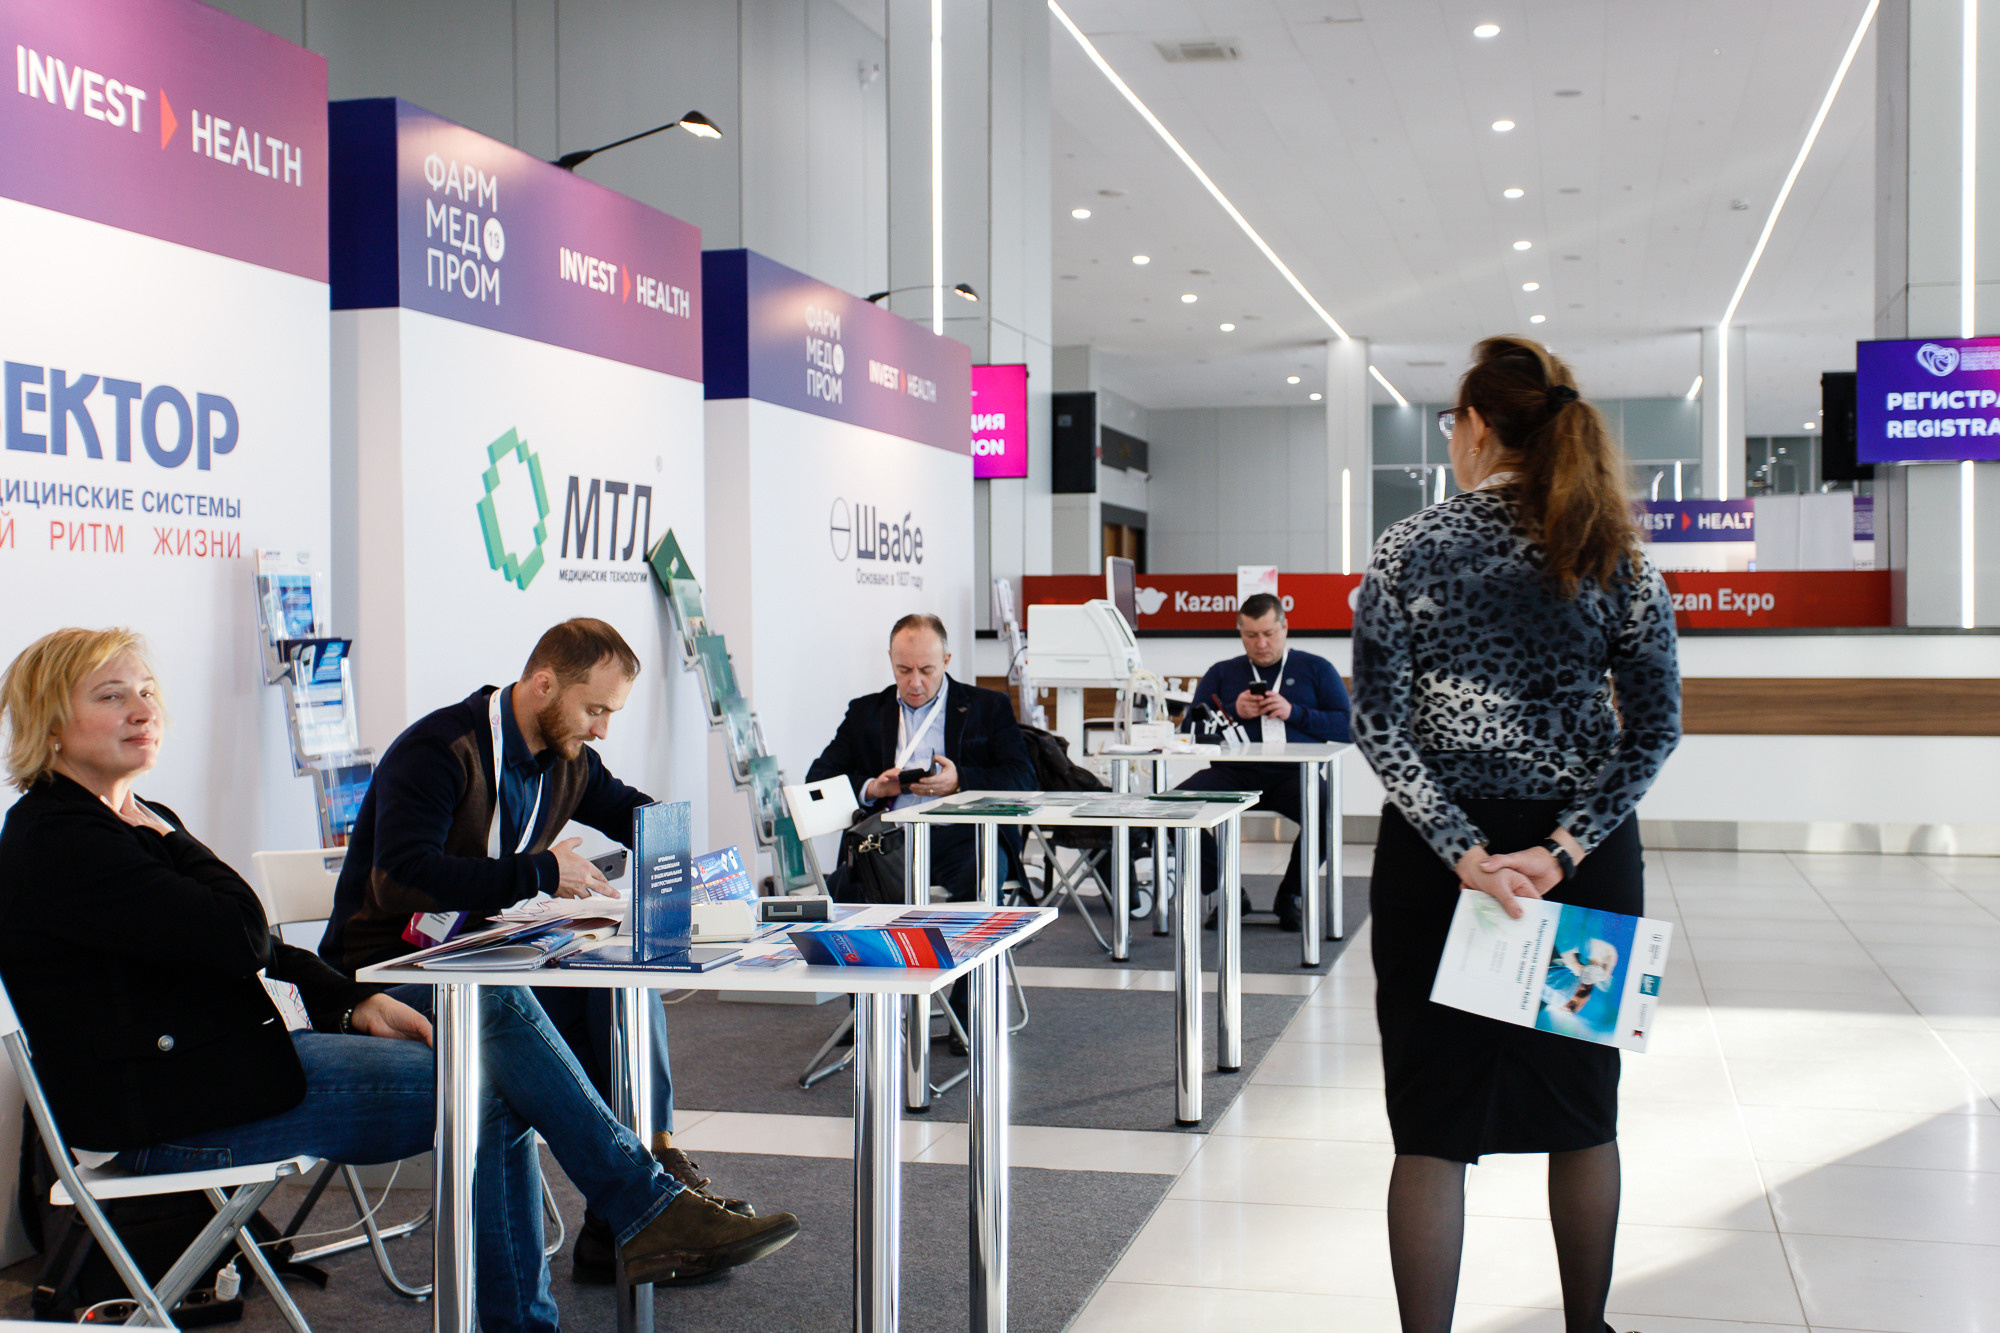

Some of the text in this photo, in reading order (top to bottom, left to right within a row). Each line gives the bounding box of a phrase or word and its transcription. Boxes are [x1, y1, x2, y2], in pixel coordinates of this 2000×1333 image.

[16, 44, 303, 188] INVEST HEALTH
[424, 151, 498, 214] ФАРМ
[426, 197, 482, 261] МЕД
[427, 246, 501, 306] ПРОМ
[560, 246, 690, 320] INVEST HEALTH
[805, 305, 842, 341] ФАРМ
[806, 335, 834, 373] МЕД
[806, 368, 843, 405] ПРОМ
[868, 359, 937, 403] INVEST HEALTH
[0, 477, 241, 519] ИЦИНСКИЕ СИСТЕМЫ
[560, 475, 652, 563] МТЛ
[50, 521, 124, 553] РИТМ
[153, 526, 241, 559] ЖИЗНИ
[856, 503, 923, 565] Швабе
[1698, 512, 1755, 530] HEALT
[559, 568, 649, 584] МЕДИЦИНСКИЕ ТЕХНОЛОГИИ
[1174, 591, 1239, 613] Kazan
[1718, 588, 1775, 617] Expo
